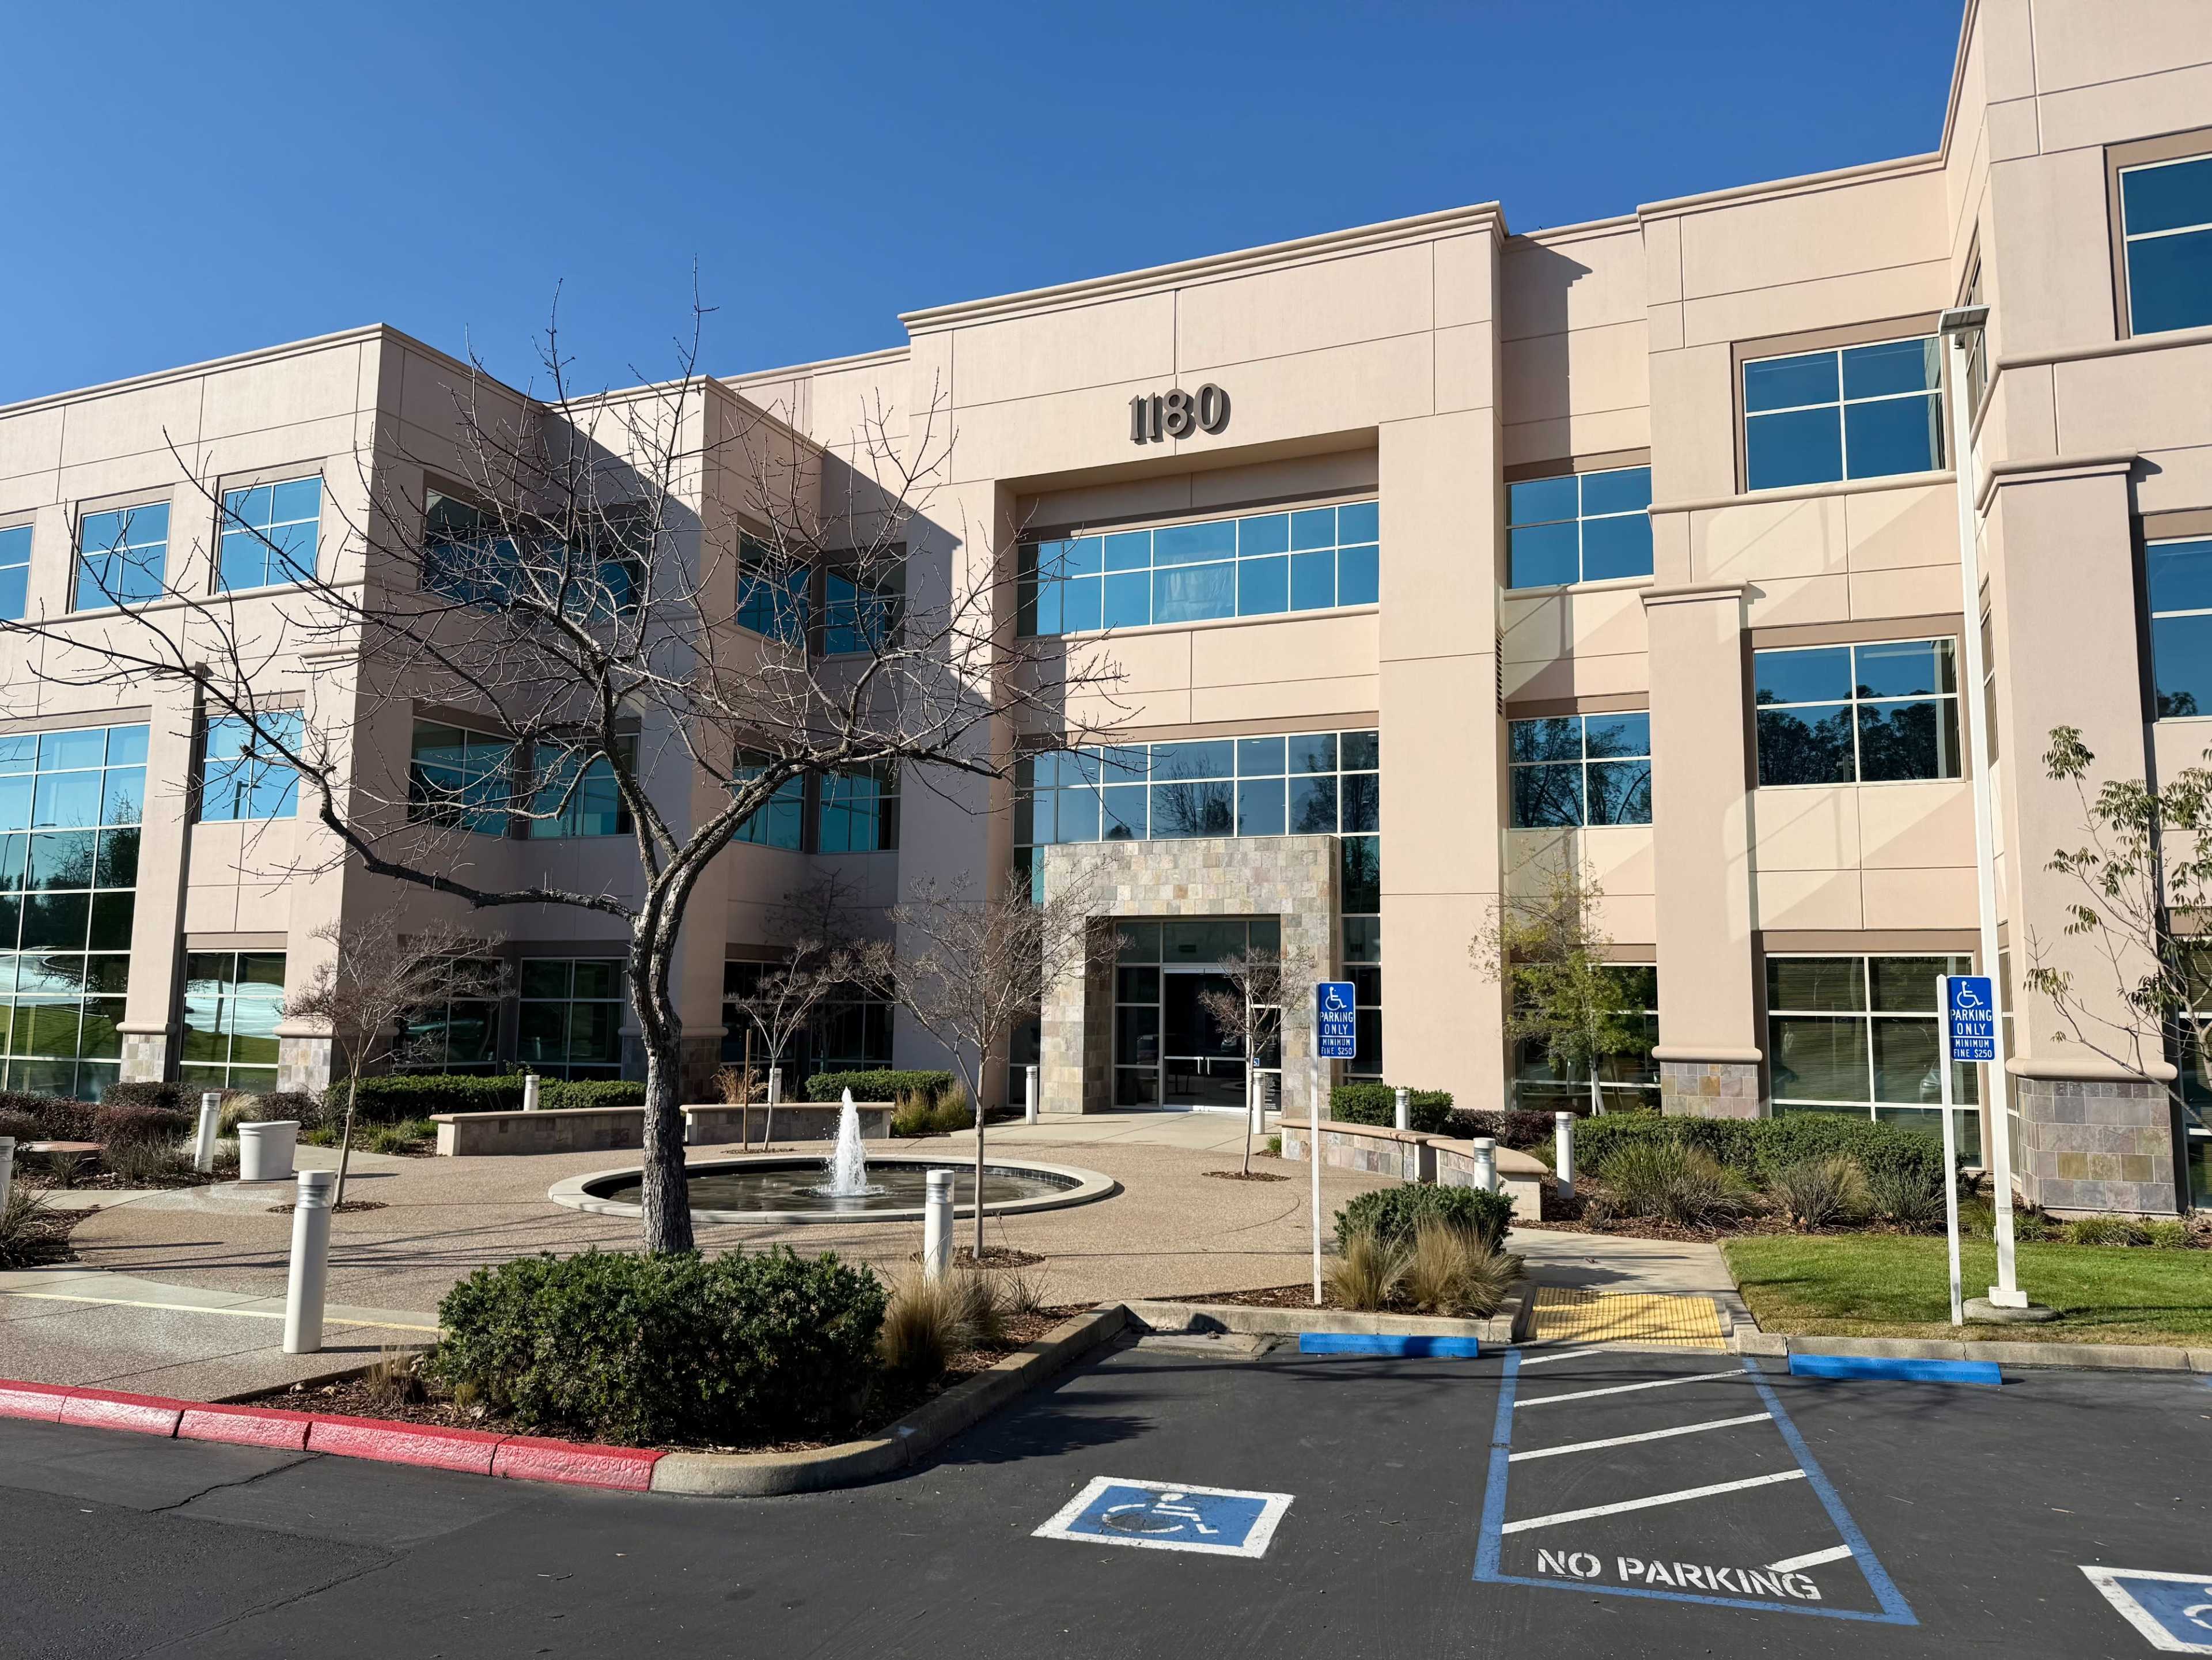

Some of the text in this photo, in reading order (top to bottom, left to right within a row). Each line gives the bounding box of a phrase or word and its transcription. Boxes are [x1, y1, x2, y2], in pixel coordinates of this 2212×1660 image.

[1128, 383, 1222, 441] 1180
[1320, 1012, 1353, 1022] PARKING
[1950, 1009, 1992, 1021] PARKING
[1324, 1024, 1347, 1035] ONLY
[1957, 1023, 1986, 1035] ONLY
[1955, 1039, 1989, 1048] MINIMUM
[1338, 1047, 1352, 1056] $250
[1953, 1049, 1992, 1058] FINE $250
[1537, 1548, 1823, 1600] NO PARKING
